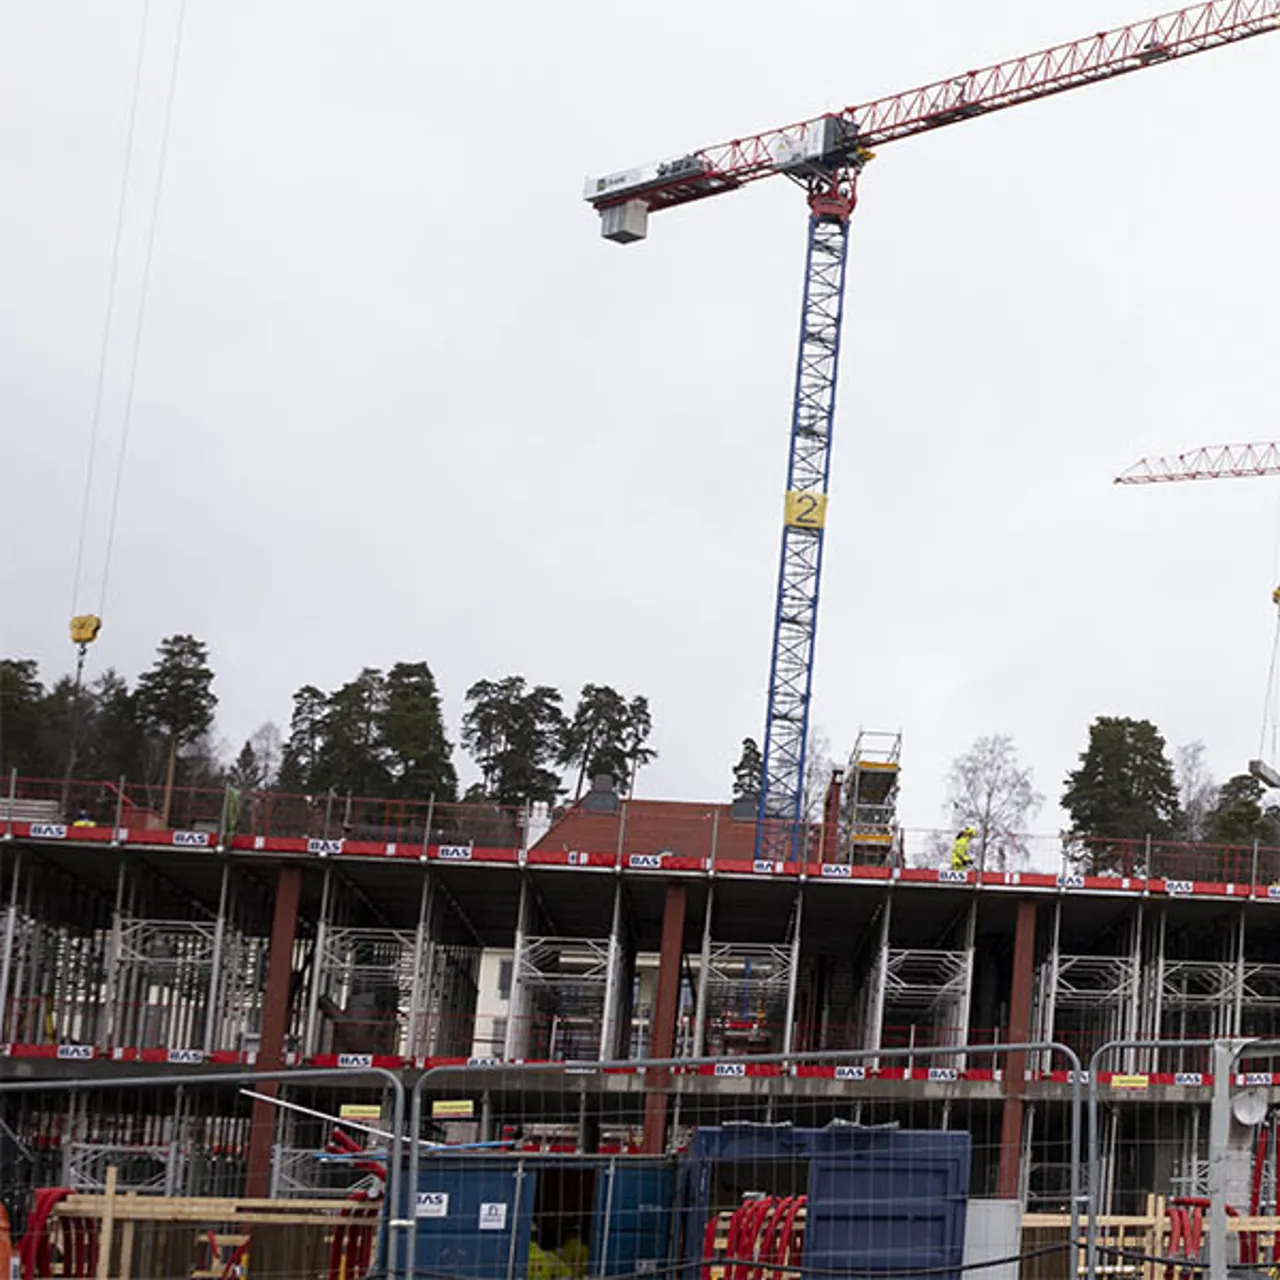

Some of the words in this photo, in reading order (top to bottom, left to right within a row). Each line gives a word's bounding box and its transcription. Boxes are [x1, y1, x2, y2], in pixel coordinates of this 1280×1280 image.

[796, 494, 818, 523] 2
[31, 824, 65, 837] BAS
[174, 833, 207, 845] BAS
[440, 847, 470, 858] BAS
[630, 856, 660, 866] BAS
[755, 861, 773, 871] BA
[938, 871, 966, 881] BAS
[58, 1045, 92, 1057] BAS
[340, 1056, 370, 1066] BAS
[716, 1065, 744, 1075] BAS
[836, 1067, 864, 1077] BAS
[929, 1069, 956, 1080] BAS
